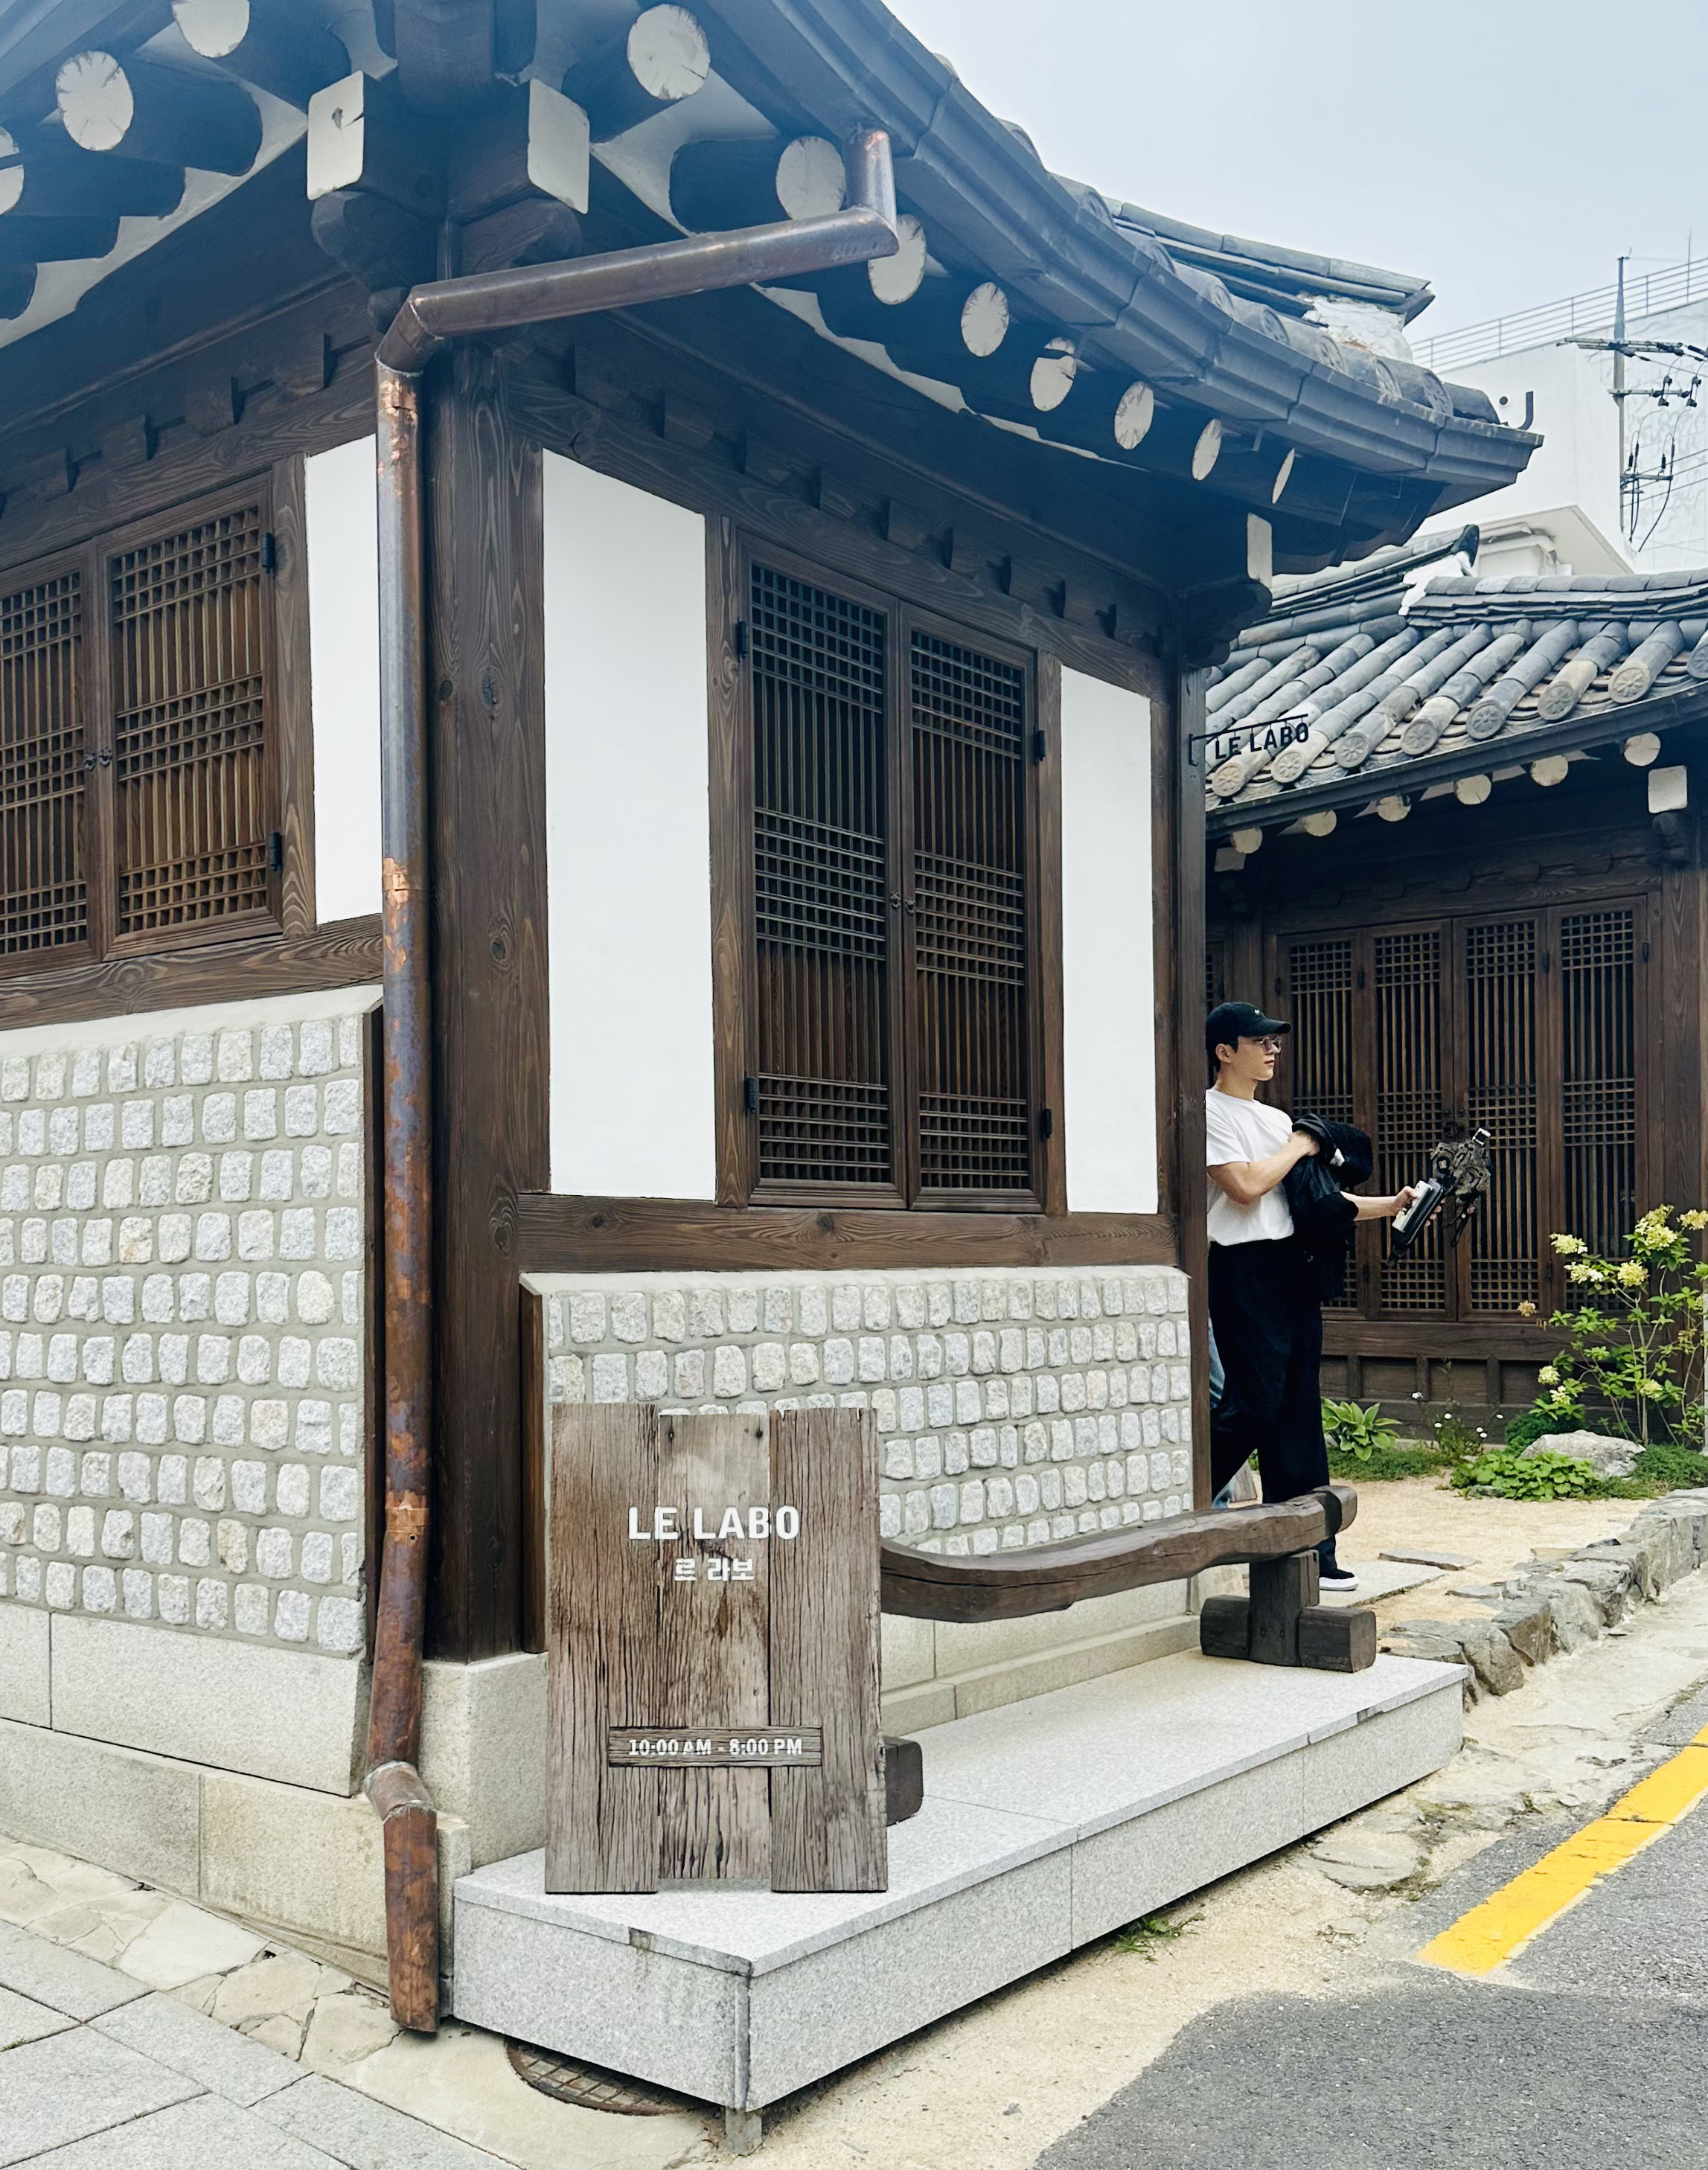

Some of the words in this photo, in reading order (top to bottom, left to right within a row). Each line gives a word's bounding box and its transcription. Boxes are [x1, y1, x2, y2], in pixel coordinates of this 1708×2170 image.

[1215, 736, 1242, 760] LE
[1250, 722, 1309, 752] LABO
[628, 1506, 679, 1540] LE
[694, 1505, 799, 1540] LABO
[674, 1558, 697, 1581] 르
[707, 1558, 755, 1581] 라보
[628, 1738, 679, 1756] 10:00
[682, 1738, 711, 1755] AM
[774, 1738, 802, 1755] PM
